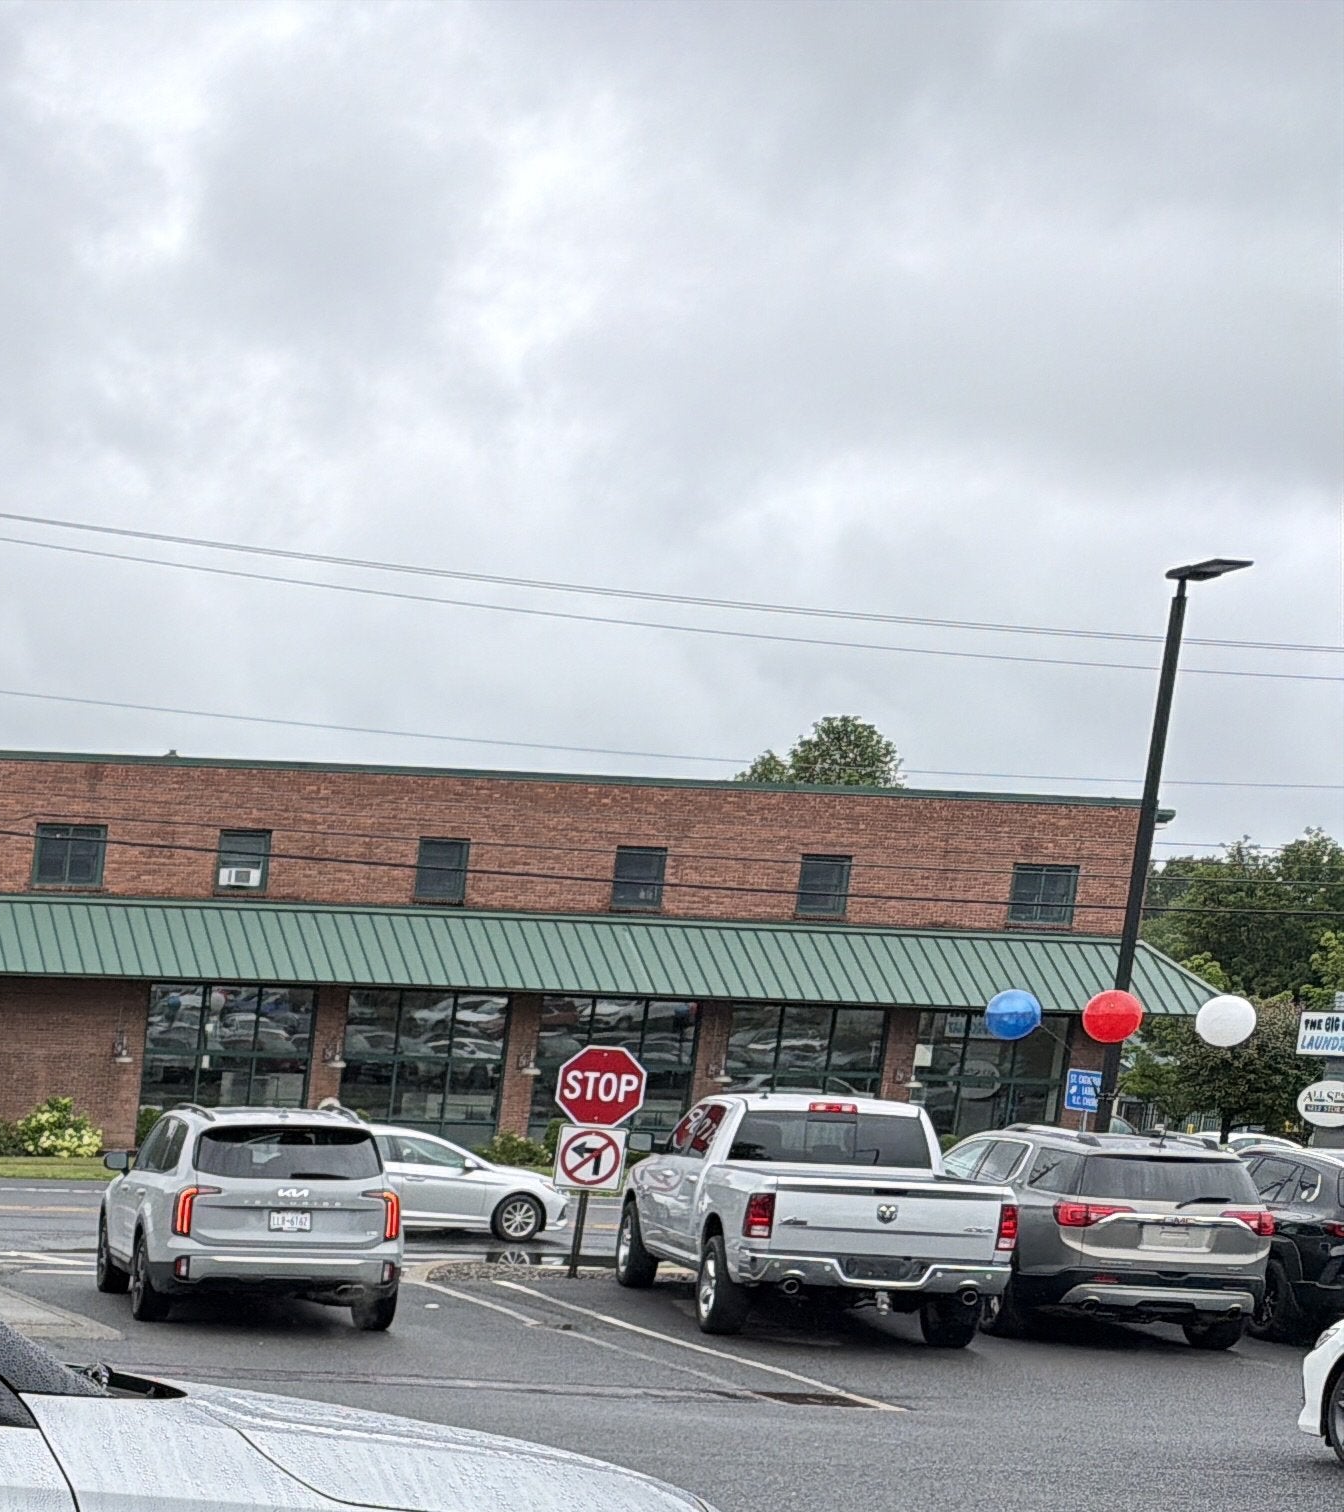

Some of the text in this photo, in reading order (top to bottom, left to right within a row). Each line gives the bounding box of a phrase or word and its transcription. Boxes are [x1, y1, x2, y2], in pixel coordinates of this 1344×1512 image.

[1304, 1016, 1340, 1033] THE BIG
[563, 1070, 639, 1103] STOP
